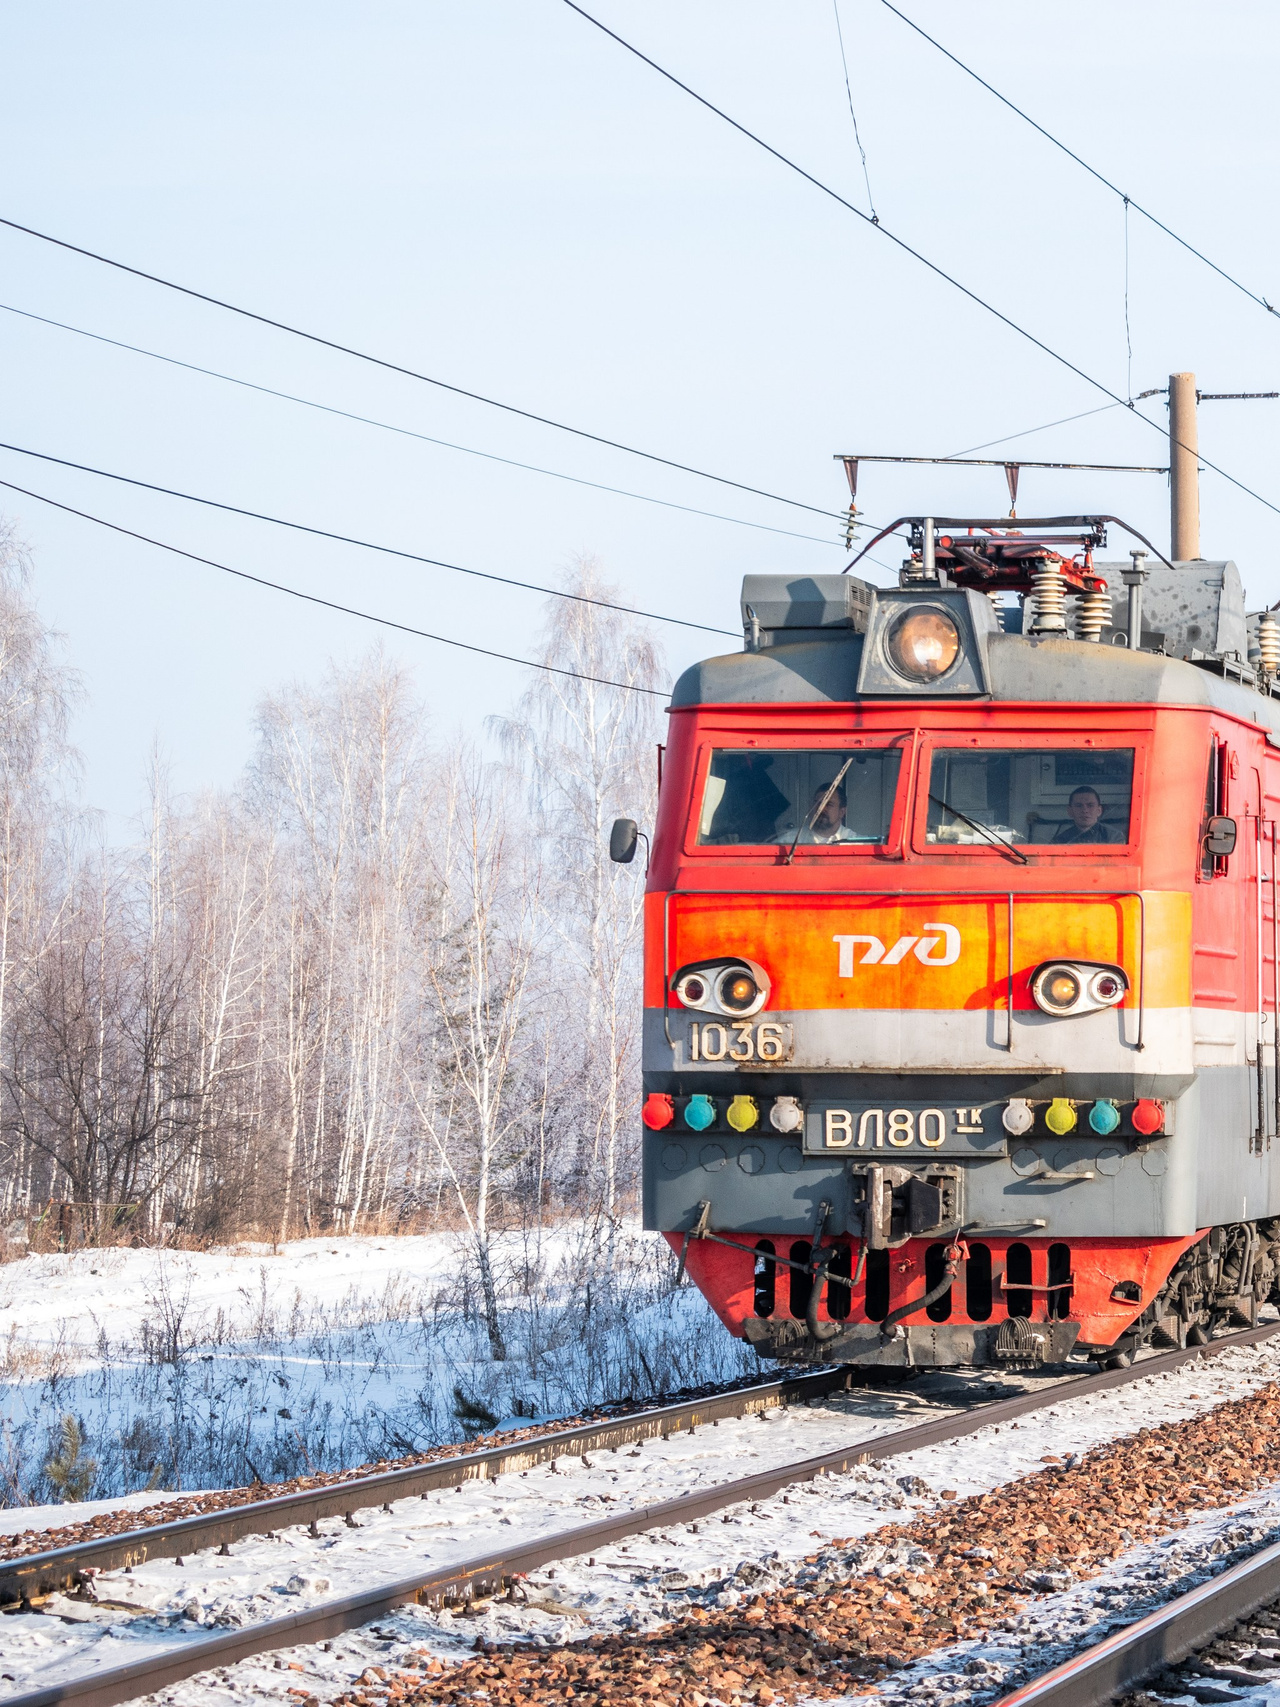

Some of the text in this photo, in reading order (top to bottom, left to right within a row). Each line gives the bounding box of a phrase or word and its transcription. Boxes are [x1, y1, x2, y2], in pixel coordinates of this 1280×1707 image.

[832, 922, 961, 978] РЖД
[692, 1022, 783, 1061] 1036
[825, 1108, 946, 1147] ВЛ80
